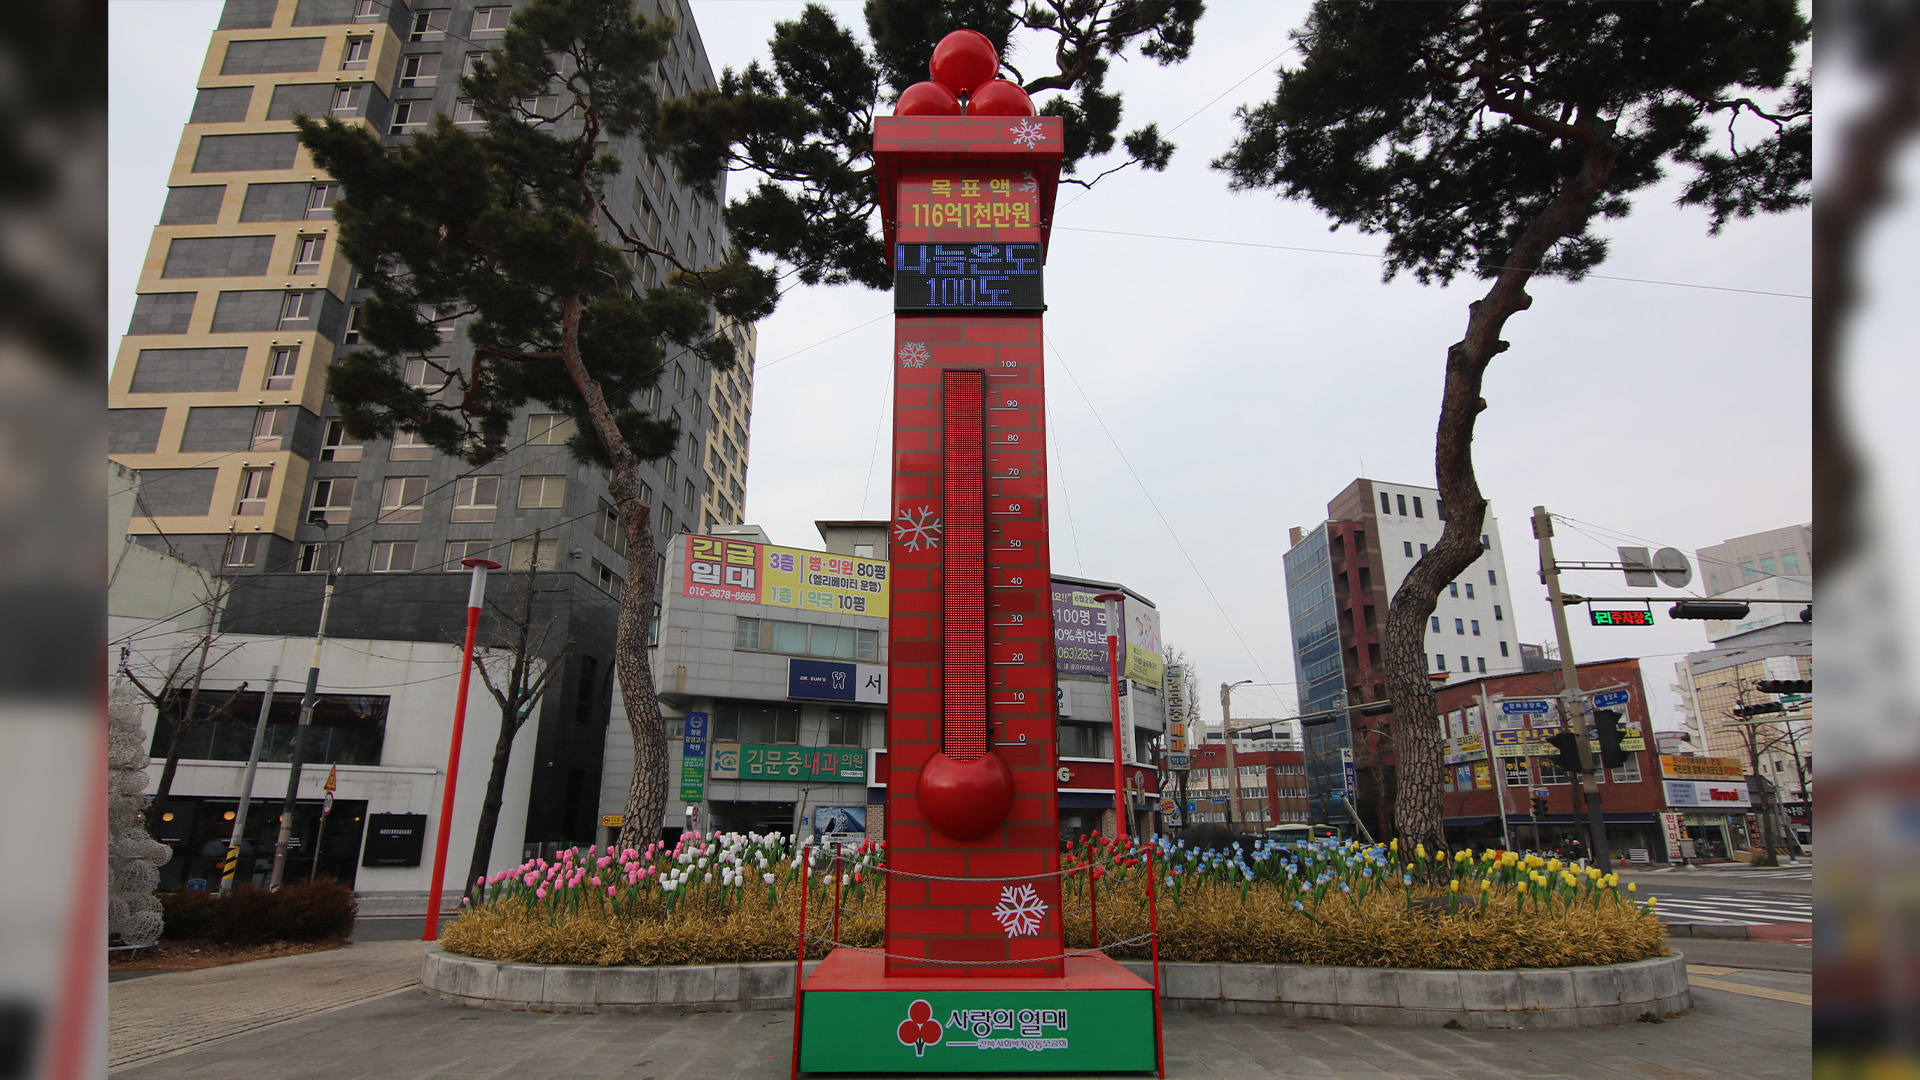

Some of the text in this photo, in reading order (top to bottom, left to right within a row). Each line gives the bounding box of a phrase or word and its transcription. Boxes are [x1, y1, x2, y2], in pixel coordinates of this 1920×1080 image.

[912, 203, 1030, 228] 116억1천만원
[897, 244, 1038, 275] 나눔온도
[926, 275, 1012, 306] 100도
[1006, 400, 1018, 408] 90
[1007, 434, 1019, 442] 80
[1008, 468, 1020, 476] 70
[1009, 504, 1021, 512] 60
[691, 537, 756, 566] 긴급
[1010, 540, 1022, 548] 50
[769, 552, 795, 573] 3층
[856, 562, 887, 580] 80평
[690, 561, 756, 589] 임대
[1010, 577, 1023, 585] 40
[689, 587, 756, 602] 010-3678-6666
[770, 586, 866, 613] 1층 약국 10평
[1011, 614, 1023, 623] 30
[1012, 653, 1024, 661] 20
[1013, 692, 1025, 701] 10
[1019, 733, 1026, 742] 0
[746, 749, 864, 776] 김문중내과 의원
[1709, 788, 1739, 801] Rinnai
[692, 806, 699, 828] 약
[1665, 814, 1678, 841] 린나이
[946, 1009, 1067, 1037] 사랑의 열매
